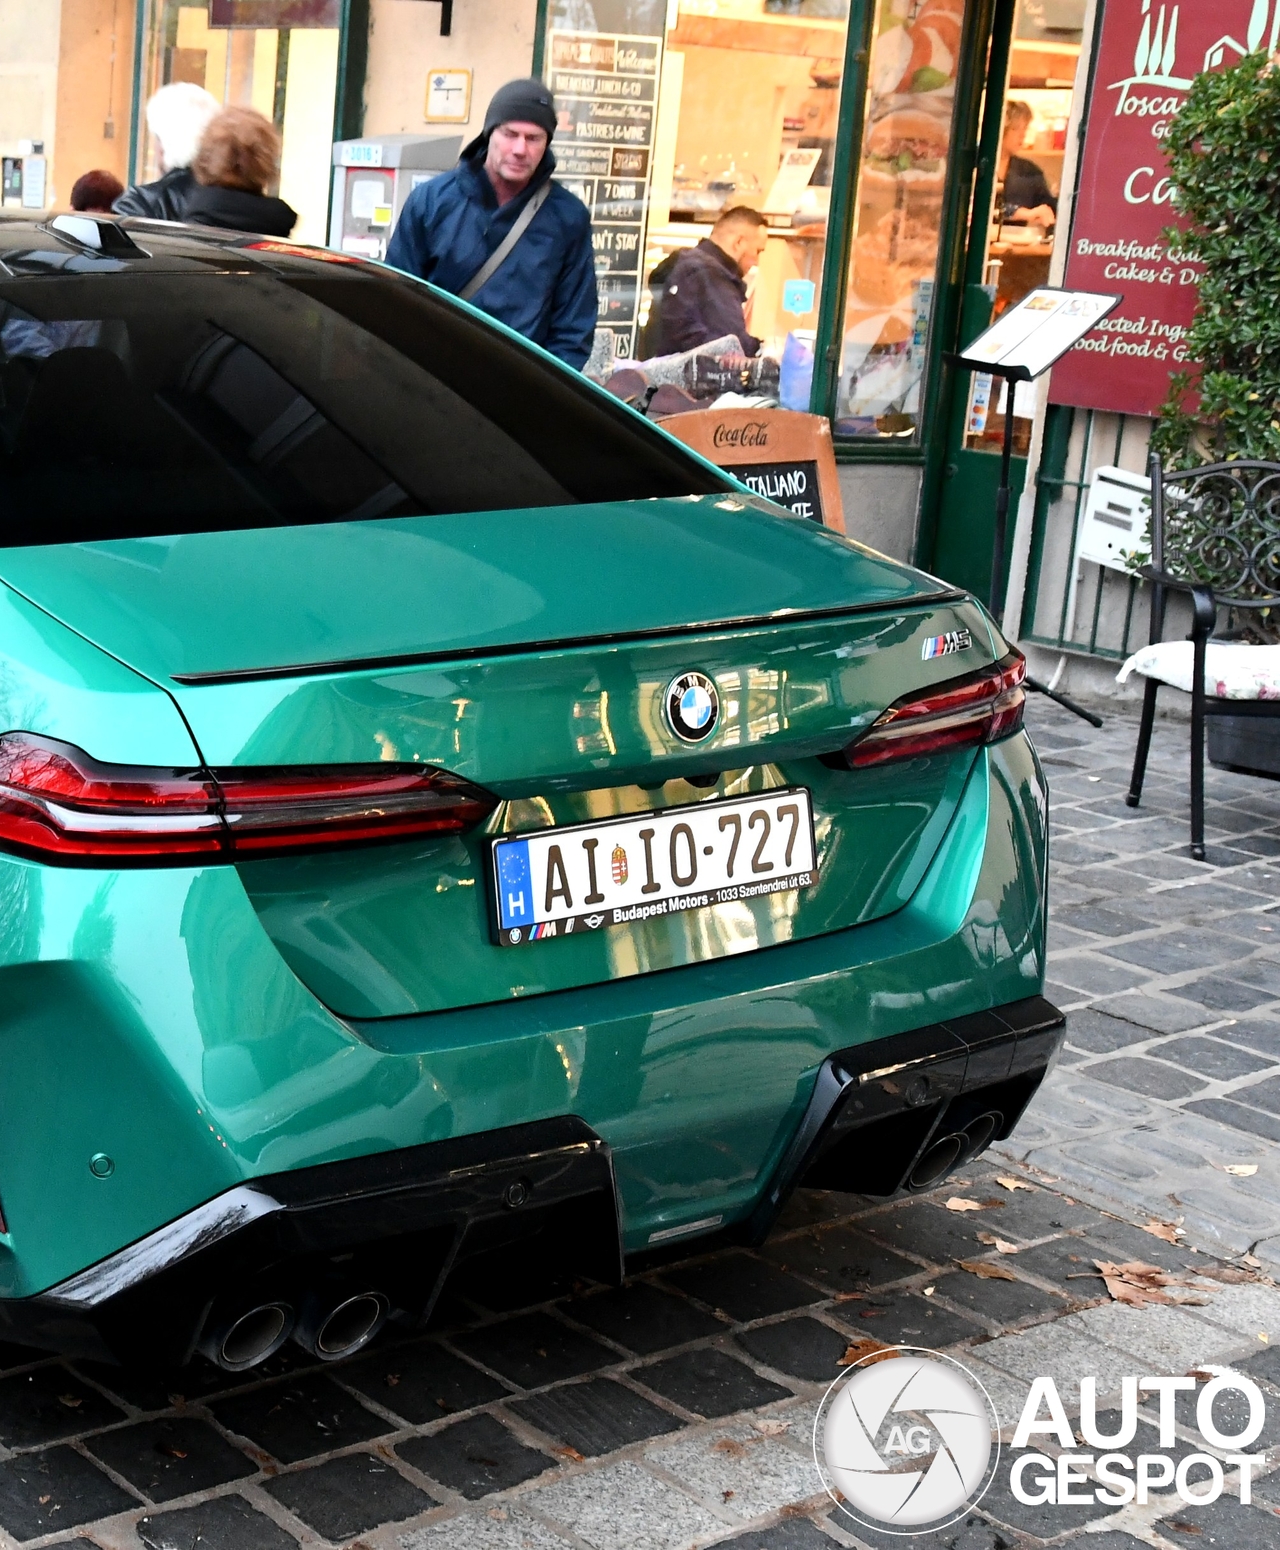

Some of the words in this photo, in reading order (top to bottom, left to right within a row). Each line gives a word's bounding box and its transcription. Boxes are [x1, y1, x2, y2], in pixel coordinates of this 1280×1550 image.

[1110, 80, 1187, 117] Tosca
[576, 121, 613, 139] PASTRIES
[624, 126, 646, 141] WINE
[612, 184, 636, 199] DAYS
[611, 204, 634, 217] WEEK
[615, 232, 638, 250] STAY
[1077, 238, 1162, 262] Breakfast,
[1104, 262, 1158, 283] Cakes
[1158, 266, 1175, 285] &
[1073, 335, 1111, 352] ood
[1110, 336, 1154, 357] food
[1153, 342, 1169, 361] &
[713, 422, 770, 448] Coca-Cola
[672, 674, 714, 699] BMW
[544, 838, 606, 913] AI
[508, 891, 525, 917] H
[613, 901, 668, 923] Budapest
[669, 894, 709, 912] Motors
[716, 888, 739, 902] 1033
[739, 878, 788, 898] Szentendrei
[788, 876, 799, 889] út
[799, 872, 813, 886] 63.
